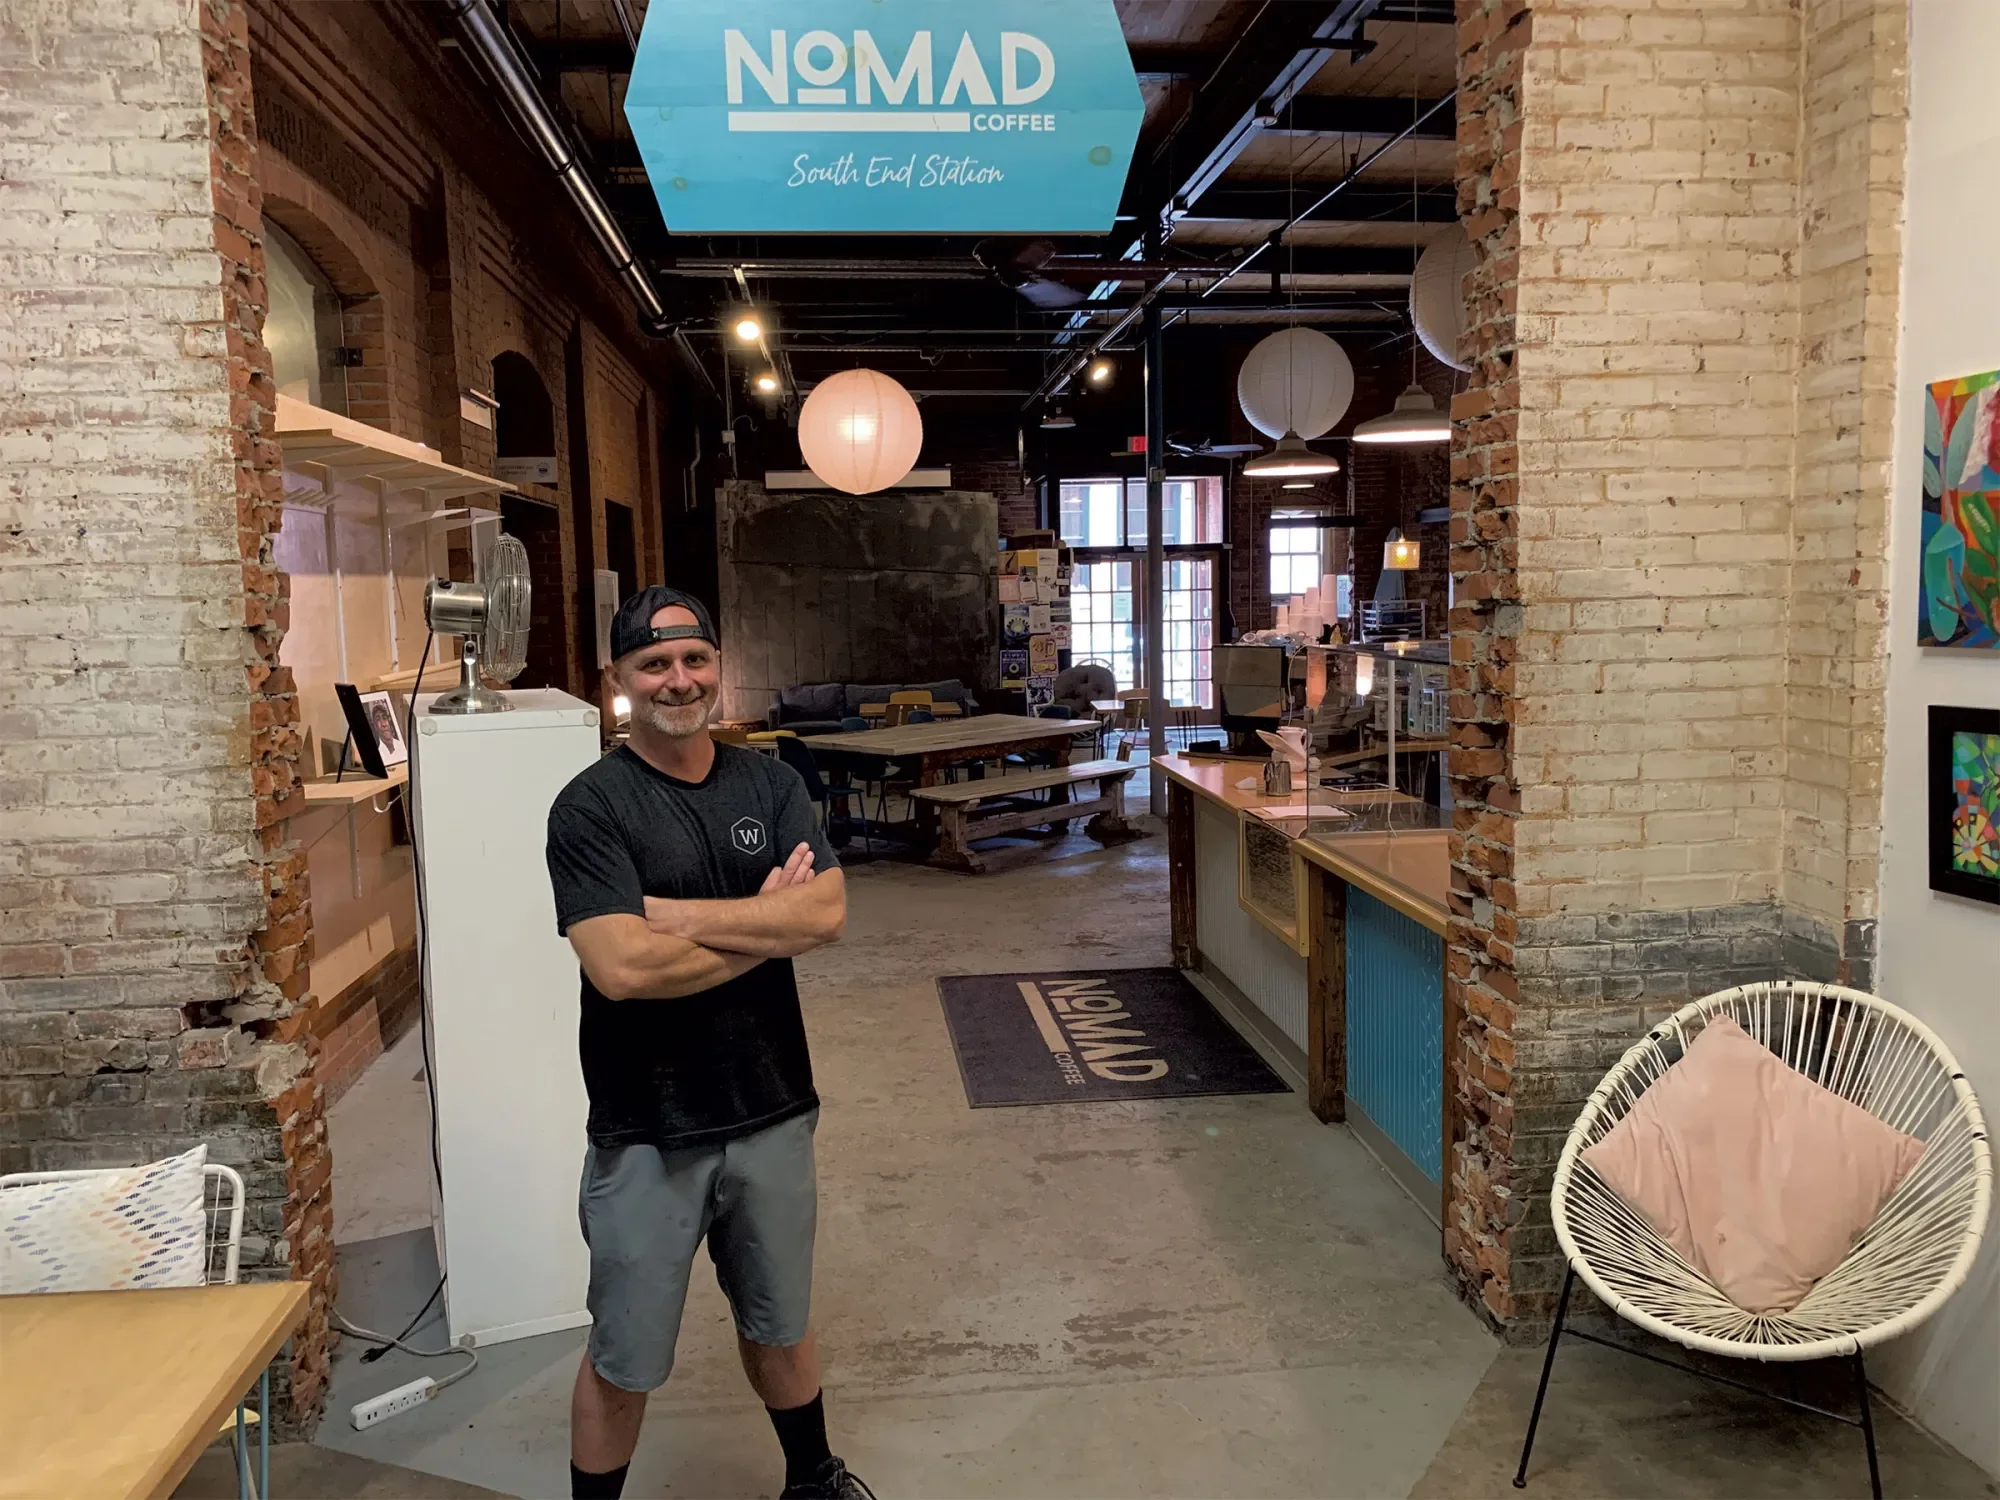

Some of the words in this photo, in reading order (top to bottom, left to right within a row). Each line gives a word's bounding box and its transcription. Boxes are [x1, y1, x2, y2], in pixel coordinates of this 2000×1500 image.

[724, 29, 1056, 105] NOMAD
[973, 114, 1056, 132] COFFEE
[787, 153, 859, 187] South
[865, 155, 917, 187] End
[919, 154, 1005, 187] Station
[738, 828, 759, 845] W
[1041, 978, 1169, 1082] NOMAD
[1053, 1052, 1086, 1085] COFFEE
